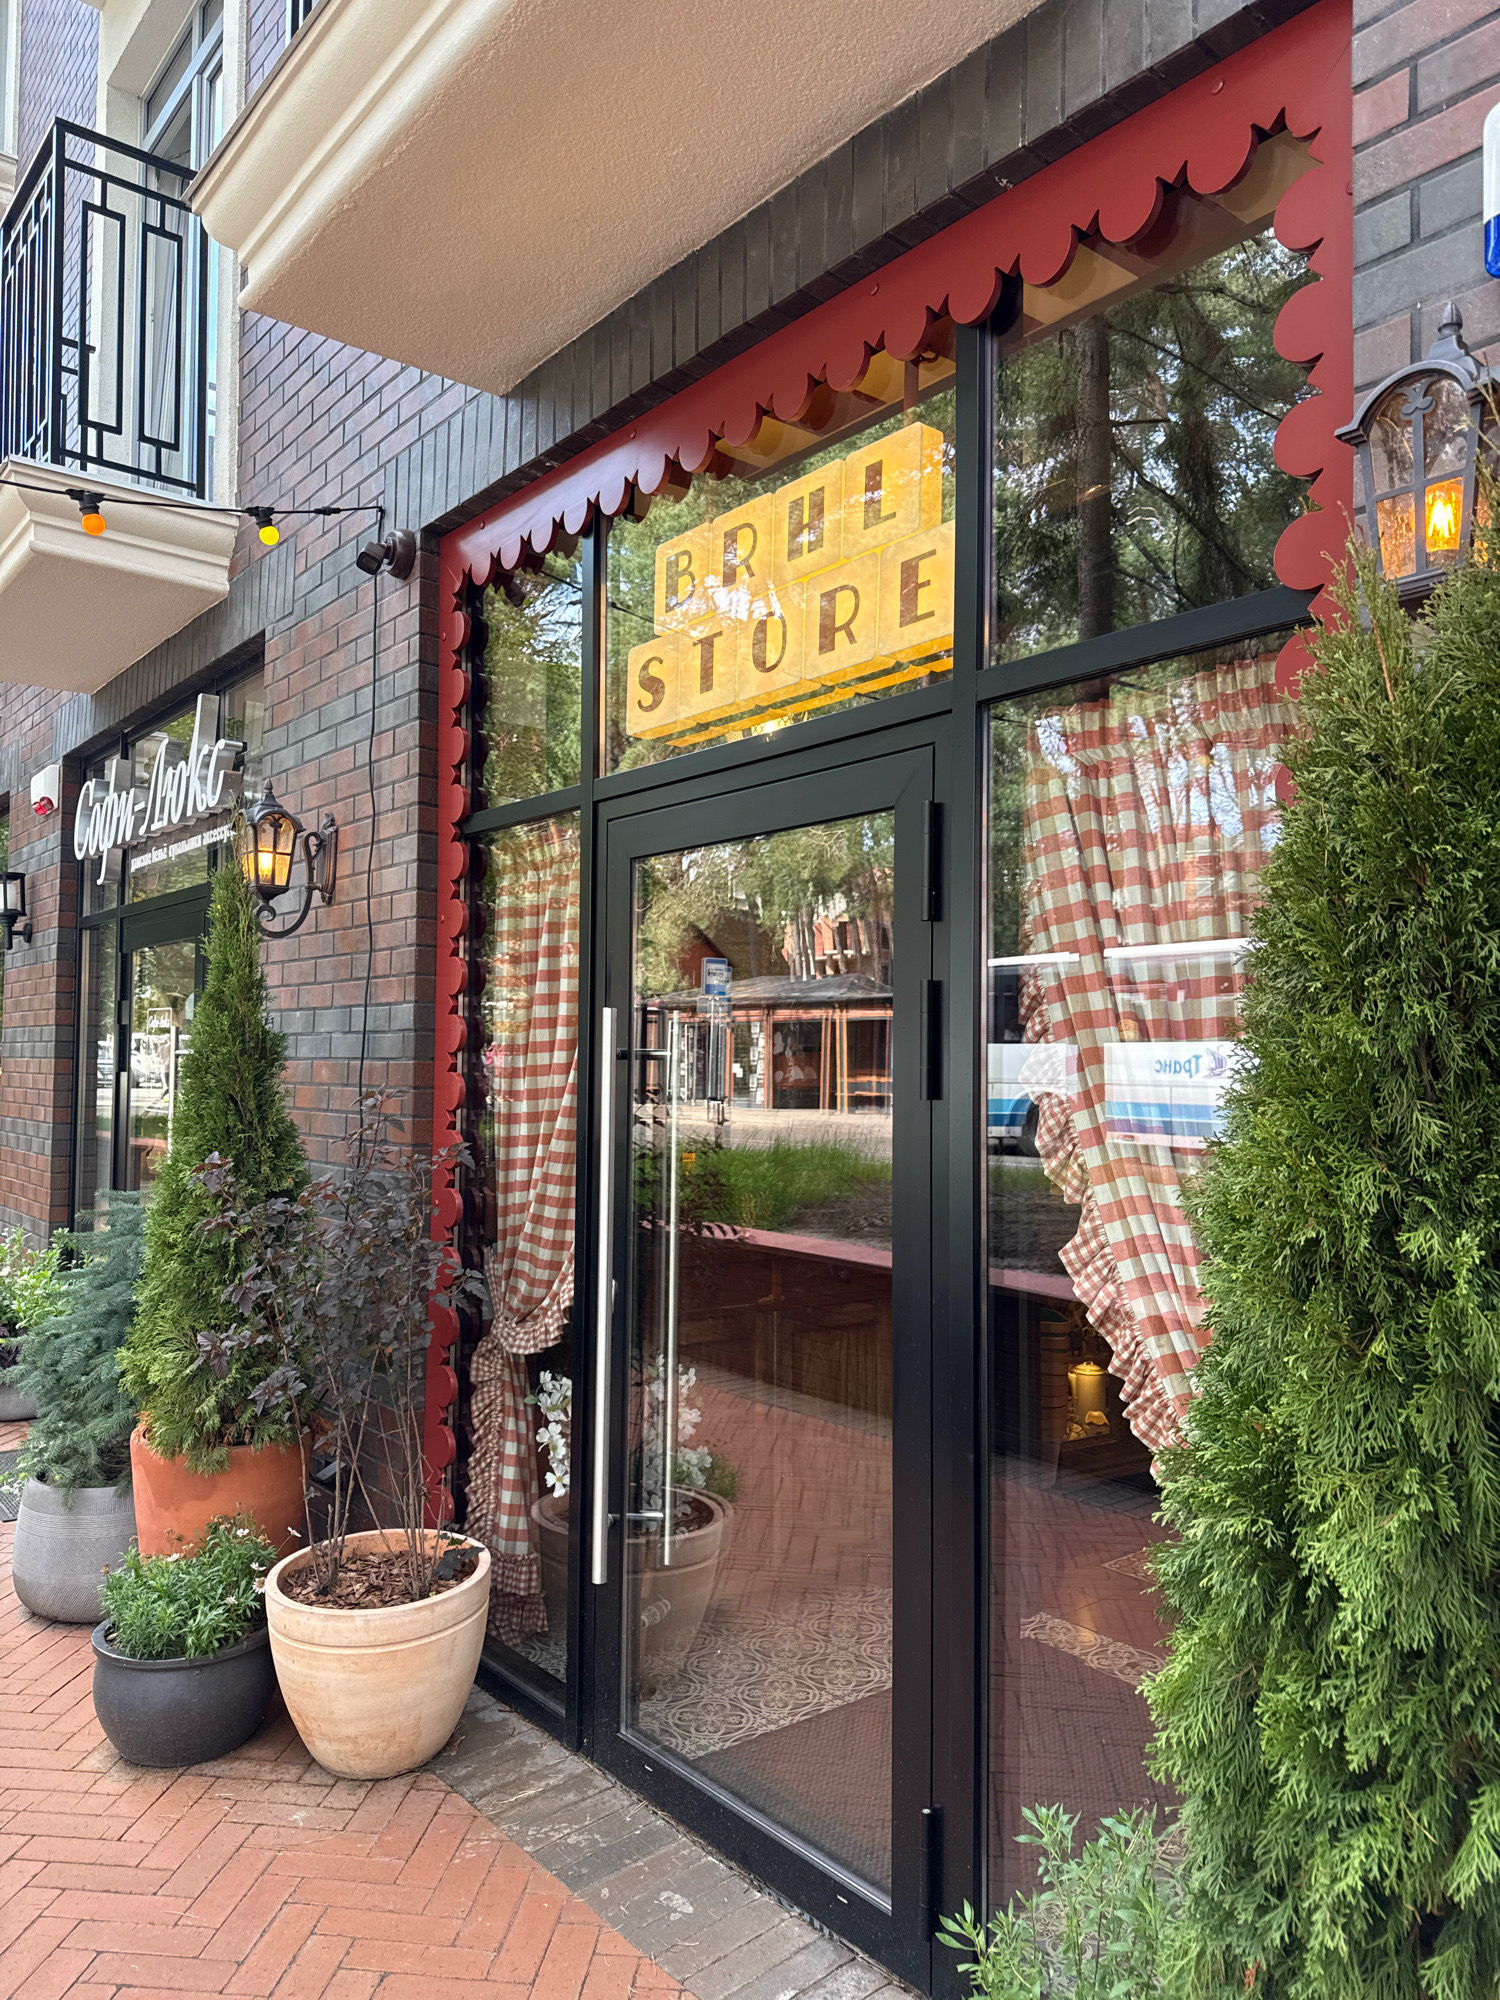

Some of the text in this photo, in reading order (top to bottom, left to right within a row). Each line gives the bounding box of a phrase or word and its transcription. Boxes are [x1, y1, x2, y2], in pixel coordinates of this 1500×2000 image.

[665, 458, 897, 614] BRHL
[636, 548, 937, 713] STORE
[74, 693, 226, 886] Софи-Люкс
